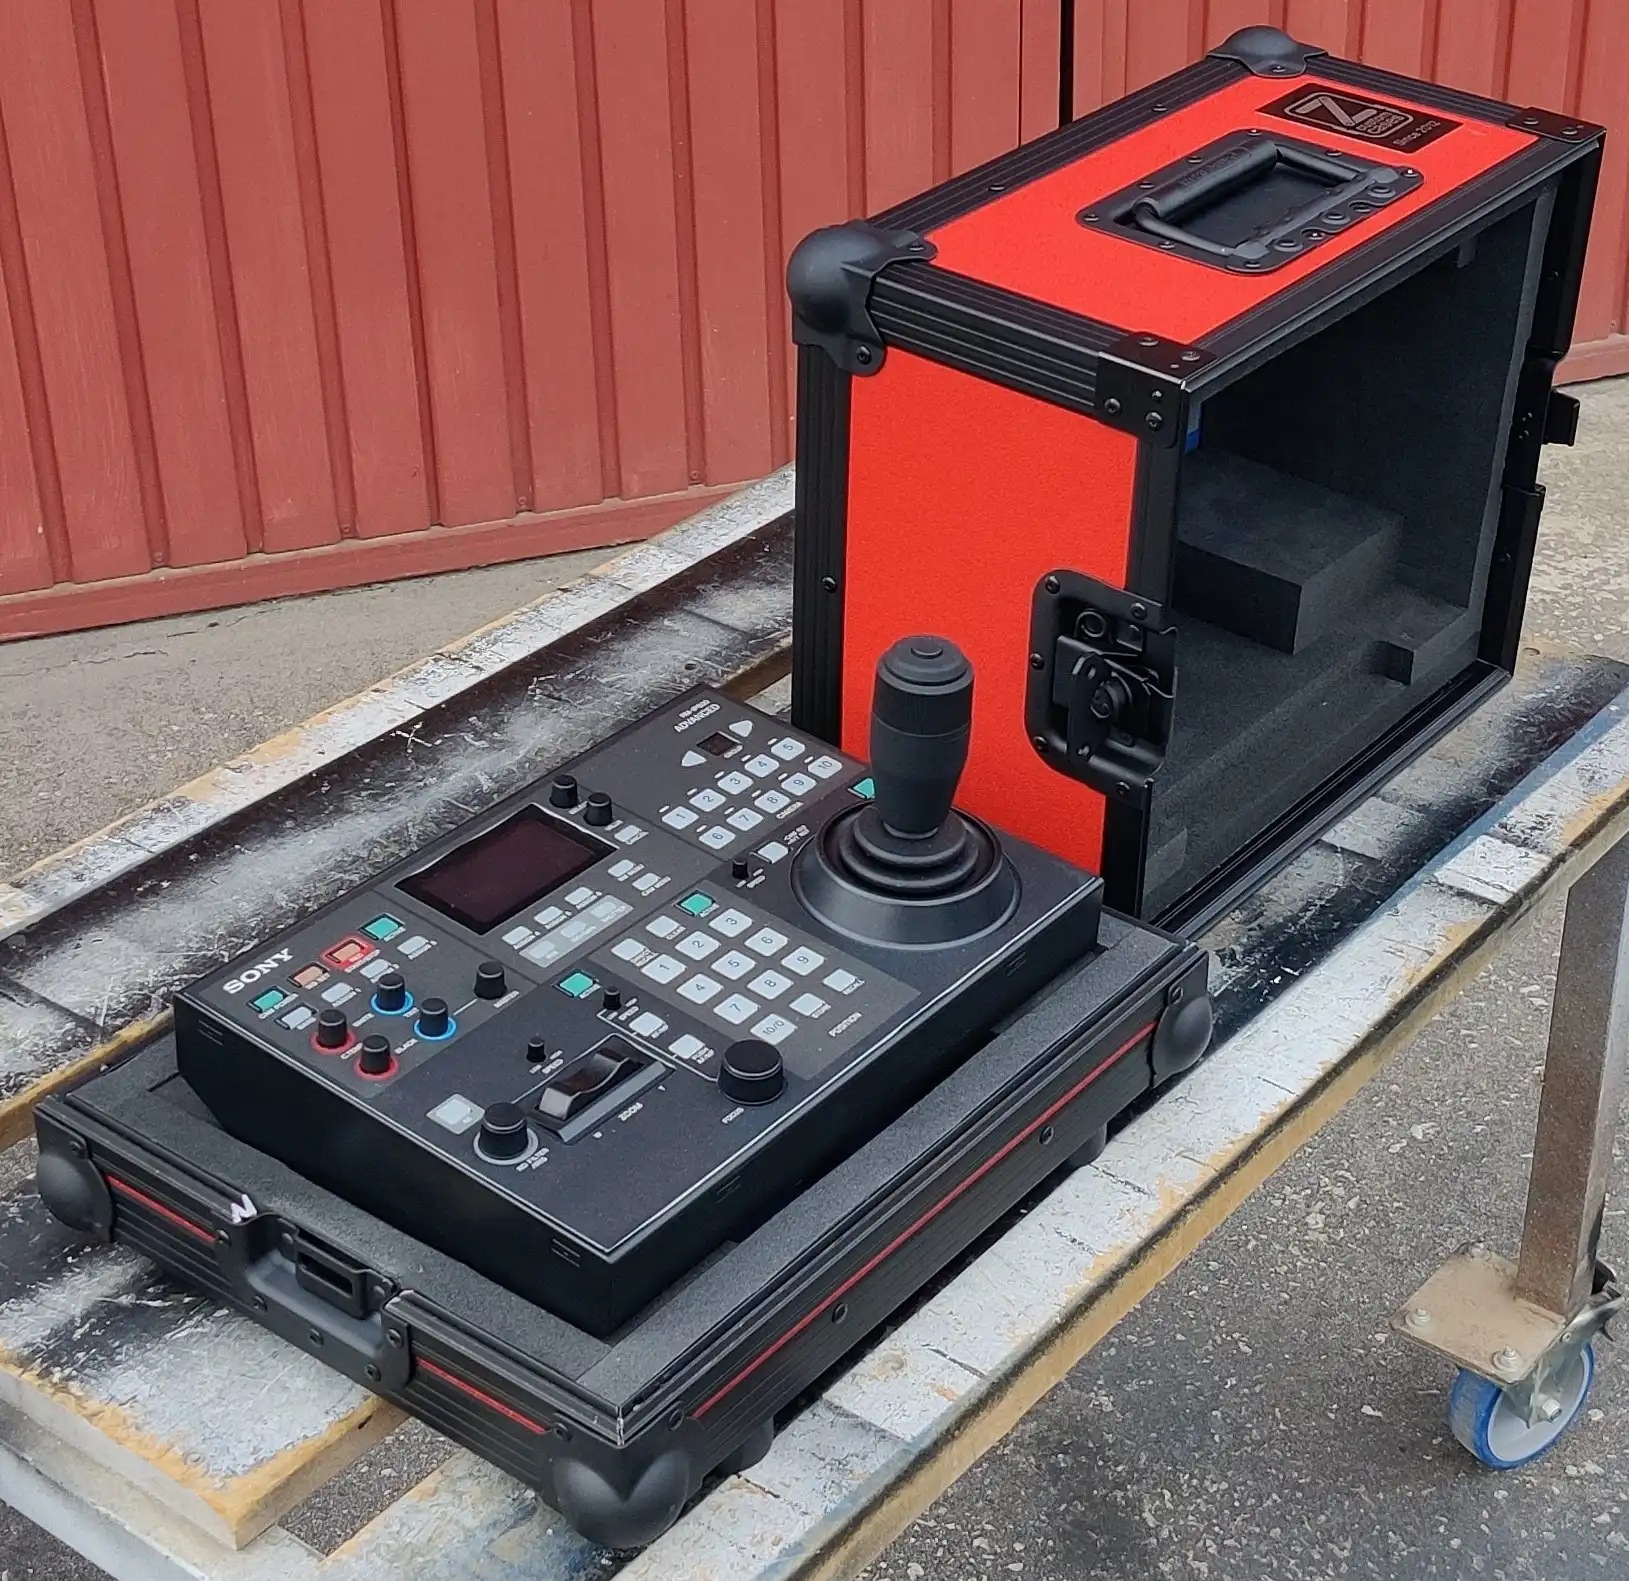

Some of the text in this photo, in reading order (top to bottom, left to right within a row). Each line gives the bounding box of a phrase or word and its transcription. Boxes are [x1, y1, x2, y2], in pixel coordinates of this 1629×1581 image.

[674, 703, 720, 732] ADVANCED
[782, 743, 794, 751] 5
[757, 760, 768, 768] 4
[817, 760, 833, 770] 10
[729, 777, 741, 785] 3
[702, 795, 715, 803] 2
[766, 796, 779, 804] 8
[776, 801, 804, 819] CAMERA
[738, 814, 750, 822] 7
[711, 832, 724, 840] 6
[725, 917, 738, 925] 3
[691, 940, 705, 949] 2
[761, 936, 773, 944] 6
[727, 959, 740, 968] 5
[796, 955, 810, 964] 9
[223, 948, 292, 994] SONY
[695, 983, 706, 991] 4
[764, 979, 777, 988] 8
[728, 1003, 741, 1012] 7
[762, 1020, 785, 1036] 10/0
[829, 1012, 862, 1037] POSITION
[618, 1102, 643, 1121] ZOOM
[722, 1107, 744, 1124] FOCUS
